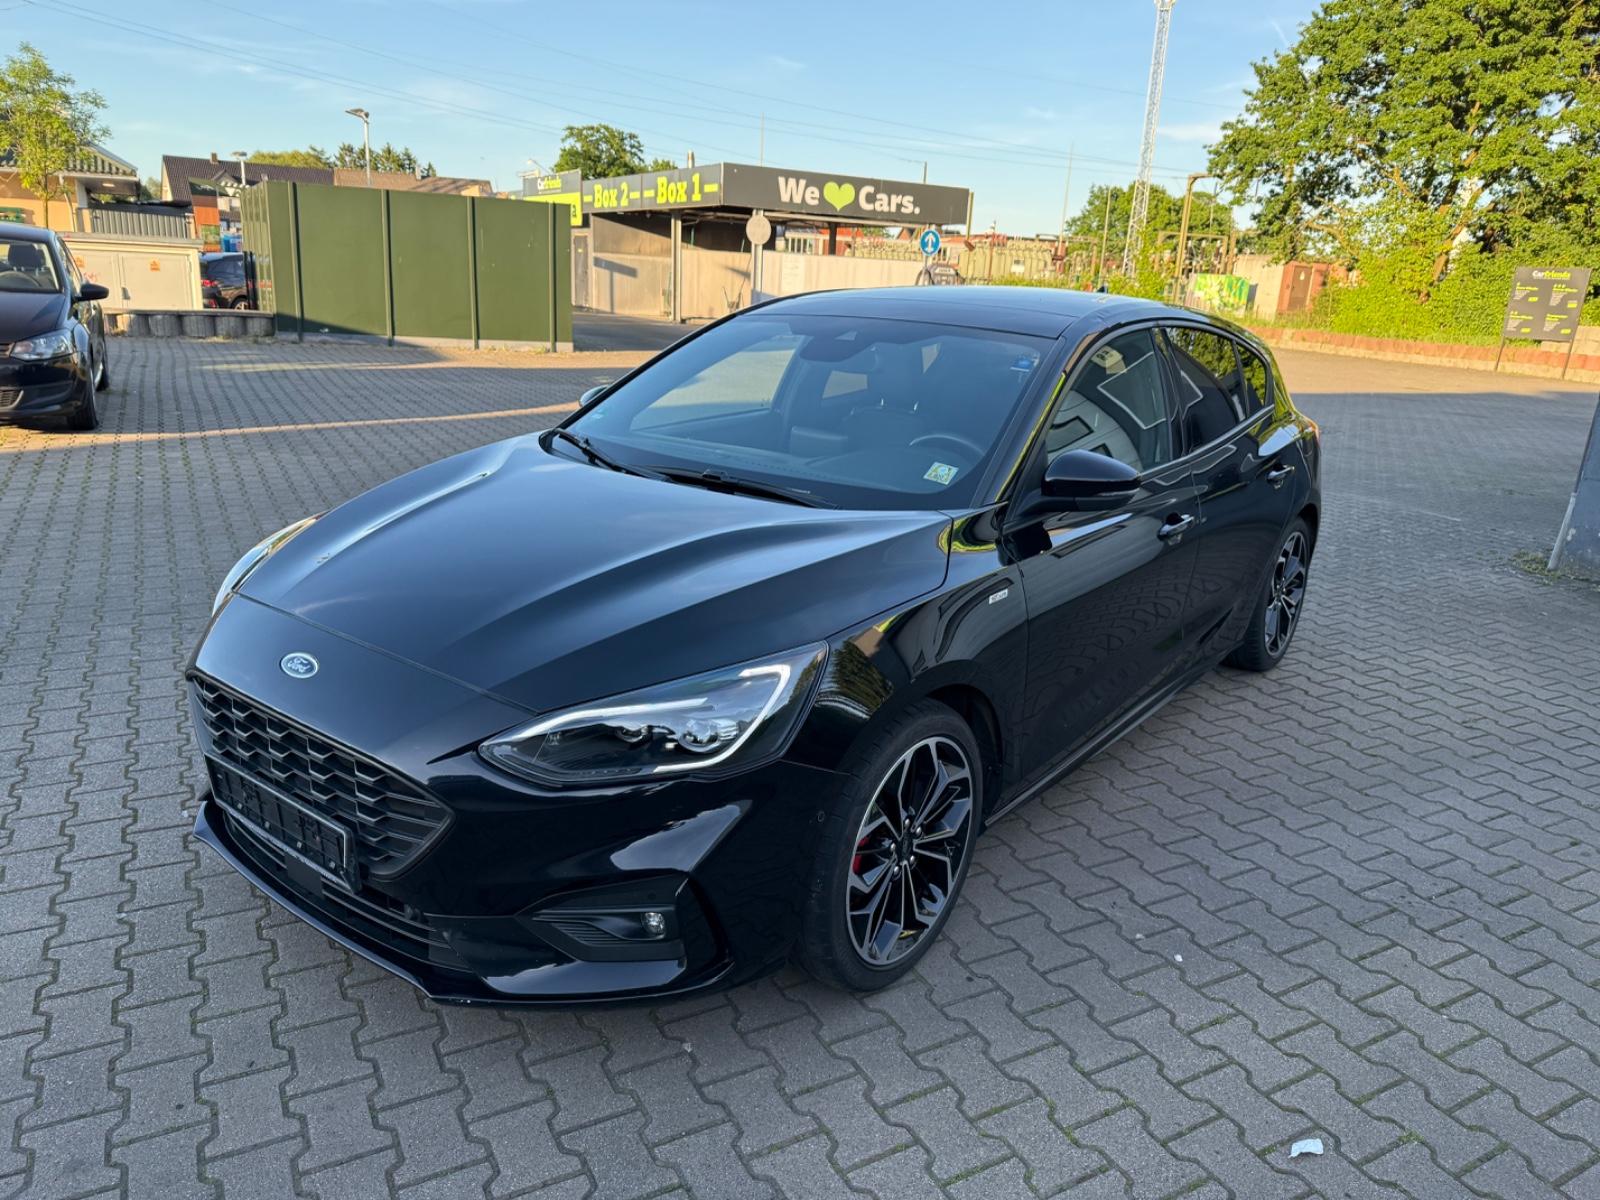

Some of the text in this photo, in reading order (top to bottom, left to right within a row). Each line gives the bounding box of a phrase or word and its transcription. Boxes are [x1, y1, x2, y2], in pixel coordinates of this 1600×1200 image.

[594, 182, 629, 208] Box 2
[656, 173, 702, 204] Box 1
[778, 176, 920, 214] We Cars.
[287, 657, 311, 673] Ford
